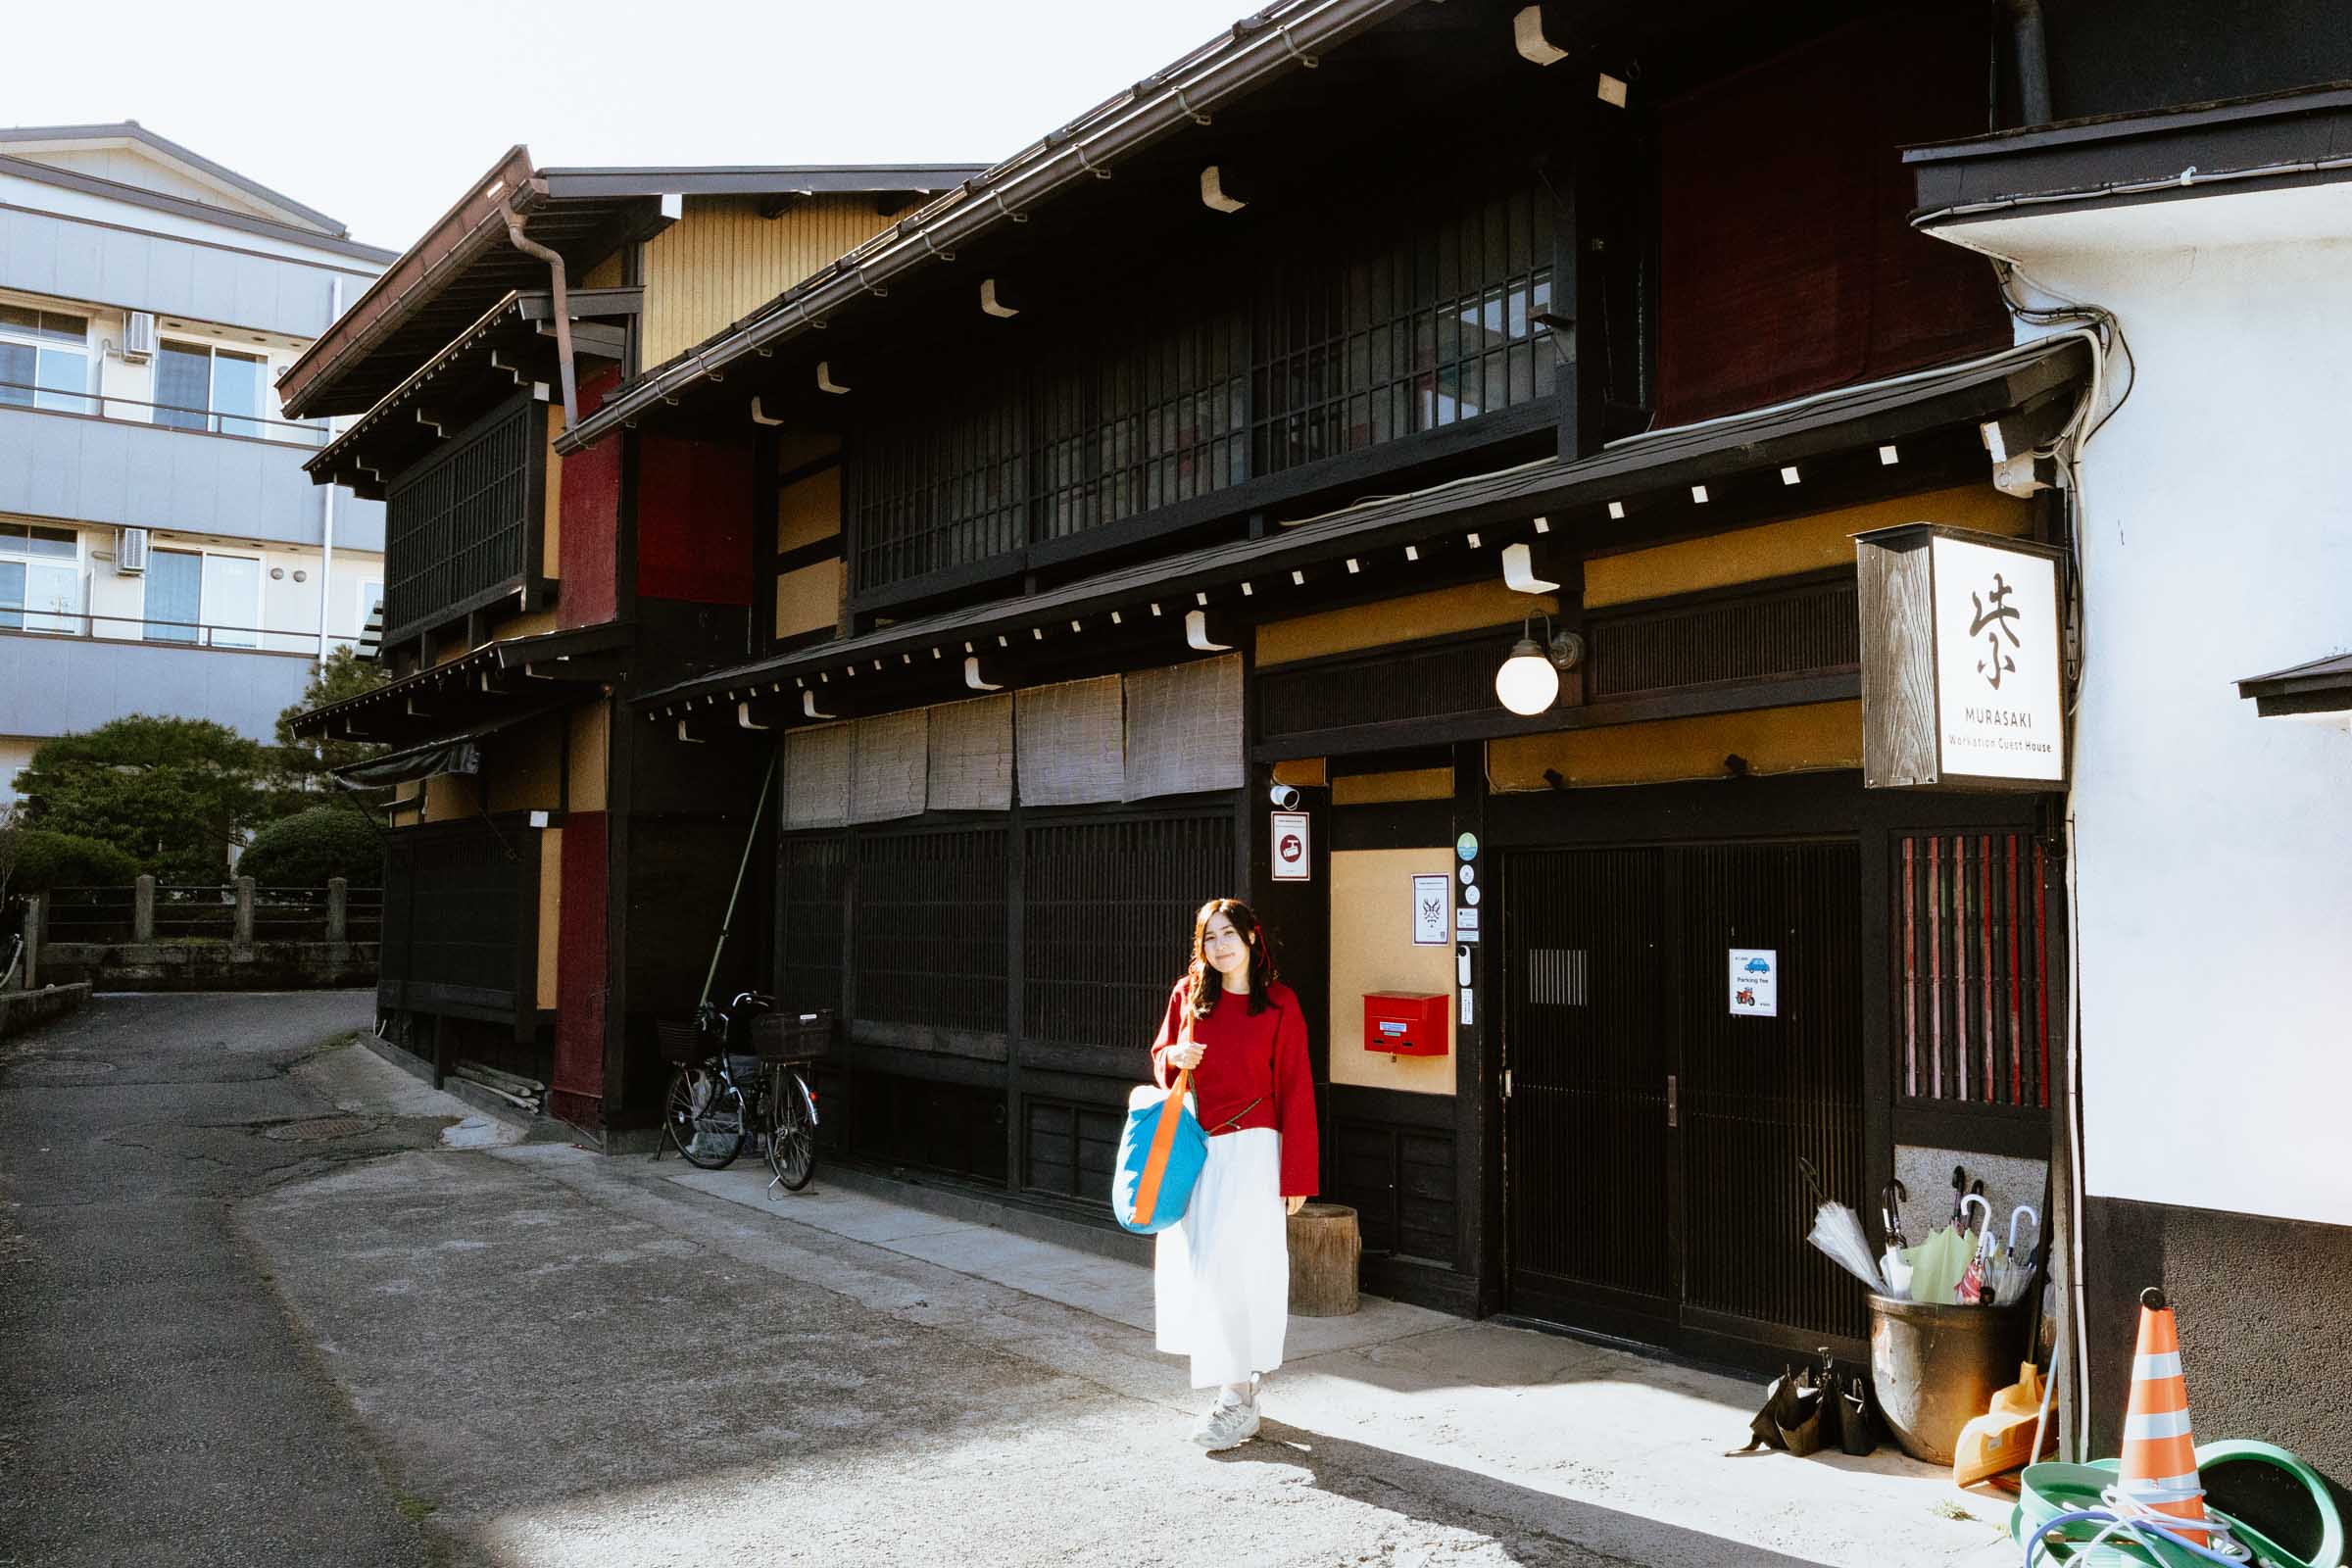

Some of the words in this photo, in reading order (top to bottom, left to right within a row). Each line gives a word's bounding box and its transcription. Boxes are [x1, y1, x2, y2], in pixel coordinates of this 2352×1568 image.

[1969, 572, 2021, 690] 紫
[1965, 708, 2032, 728] MURASAKI
[1997, 737, 2024, 751] Guest
[2025, 740, 2052, 753] House
